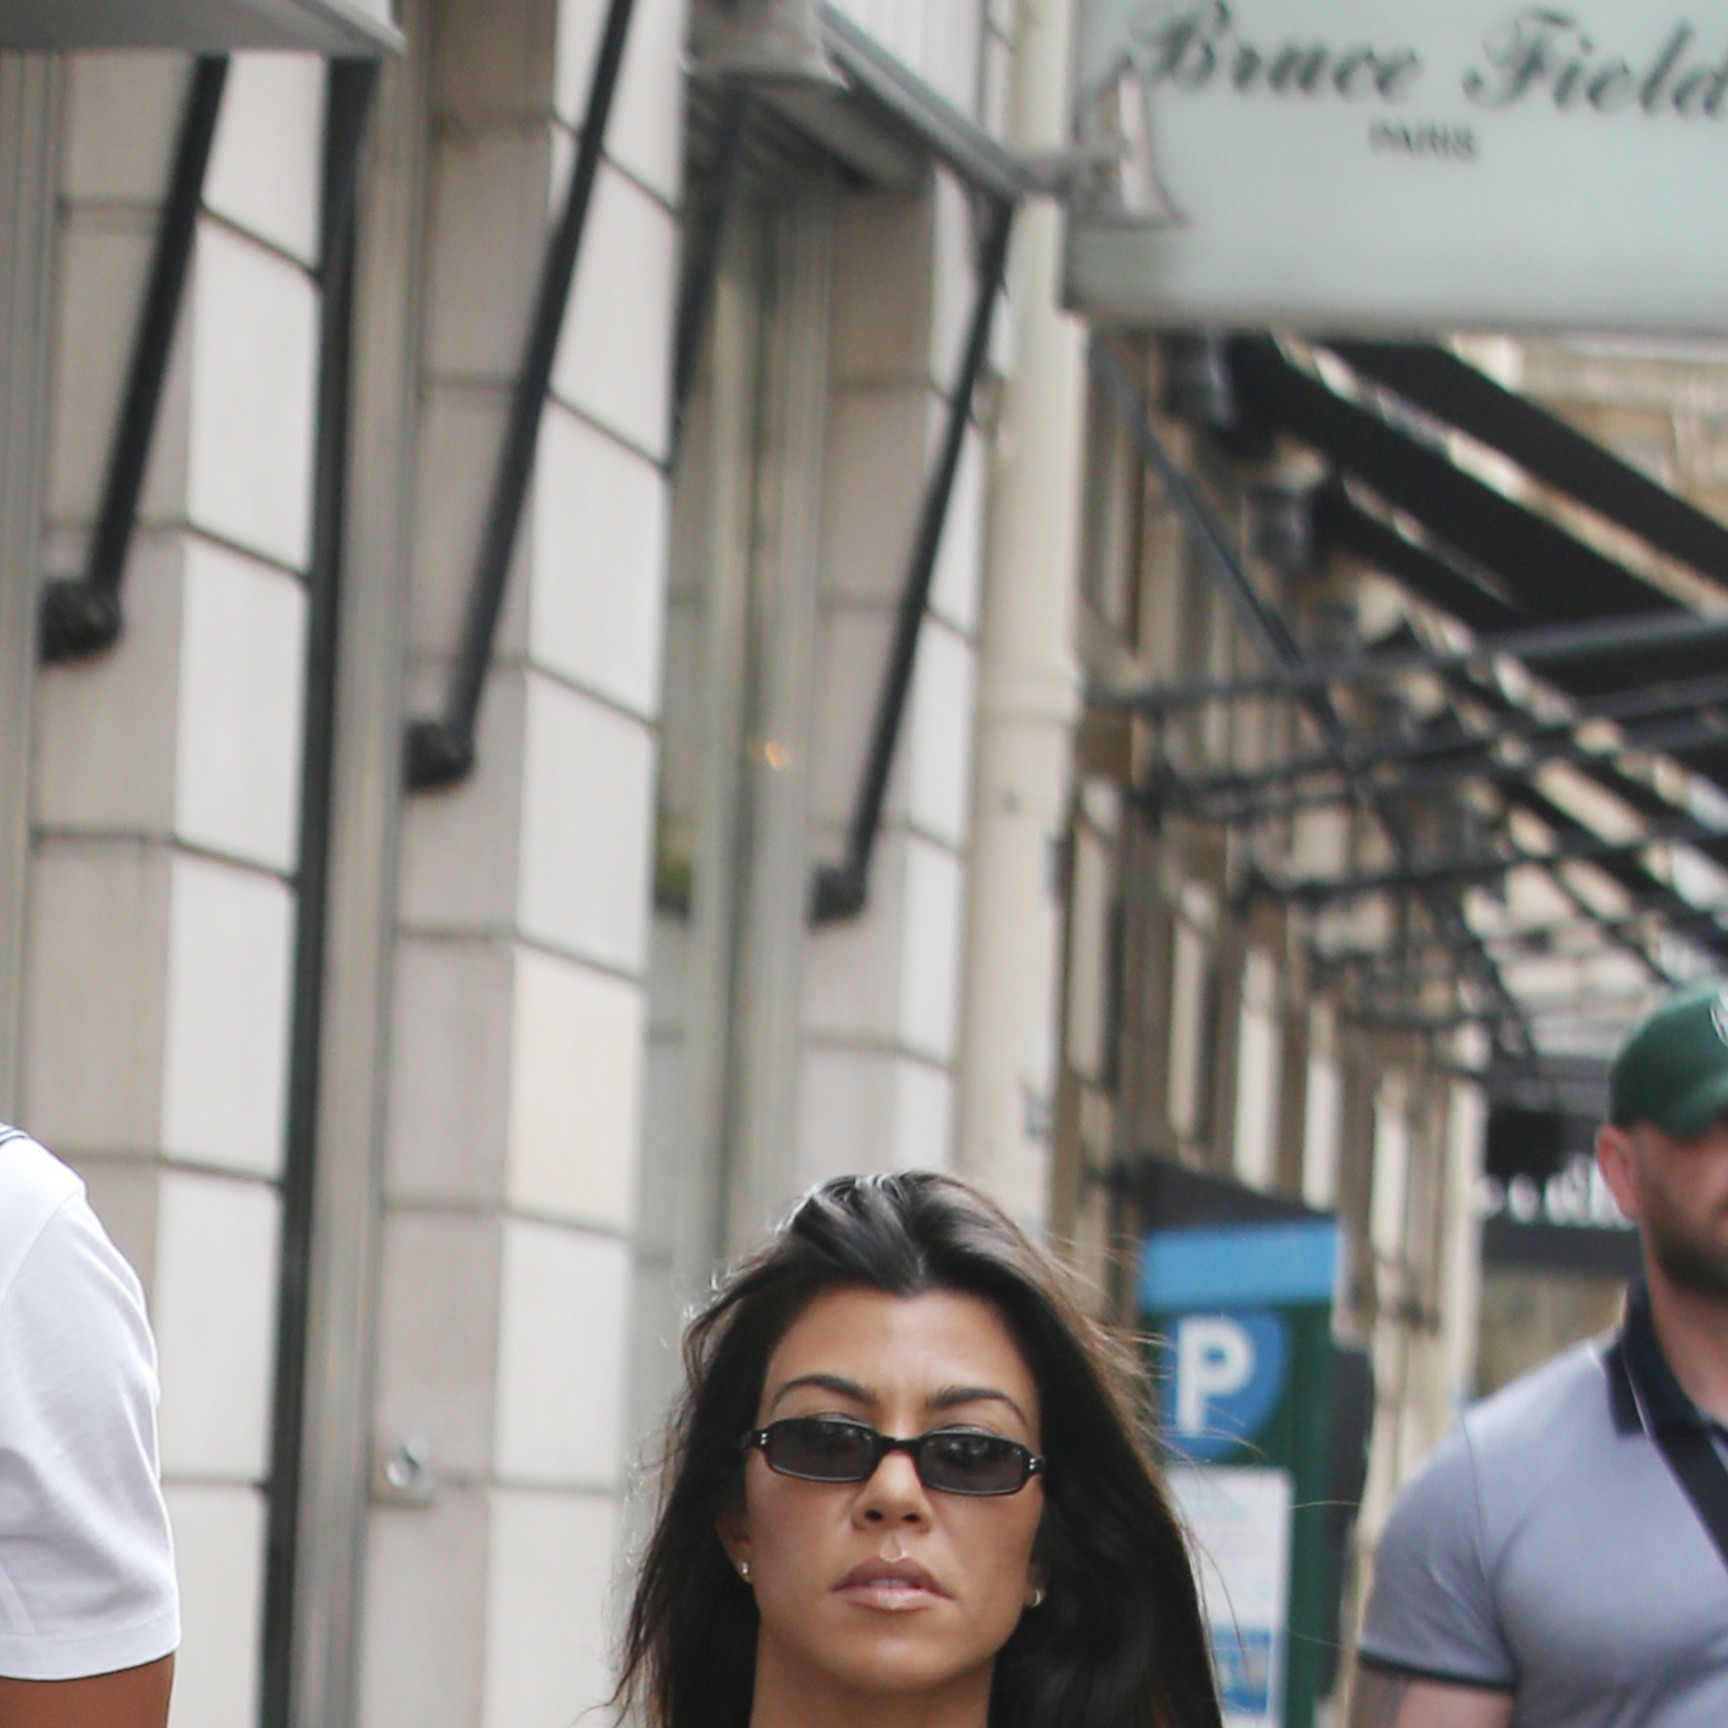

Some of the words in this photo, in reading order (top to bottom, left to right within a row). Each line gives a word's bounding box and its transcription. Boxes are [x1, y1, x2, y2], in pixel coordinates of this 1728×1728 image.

[1126, 0, 1419, 97] Bruce
[1463, 8, 1728, 118] Field
[1369, 121, 1476, 159] PARIS
[1178, 1315, 1256, 1434] P
